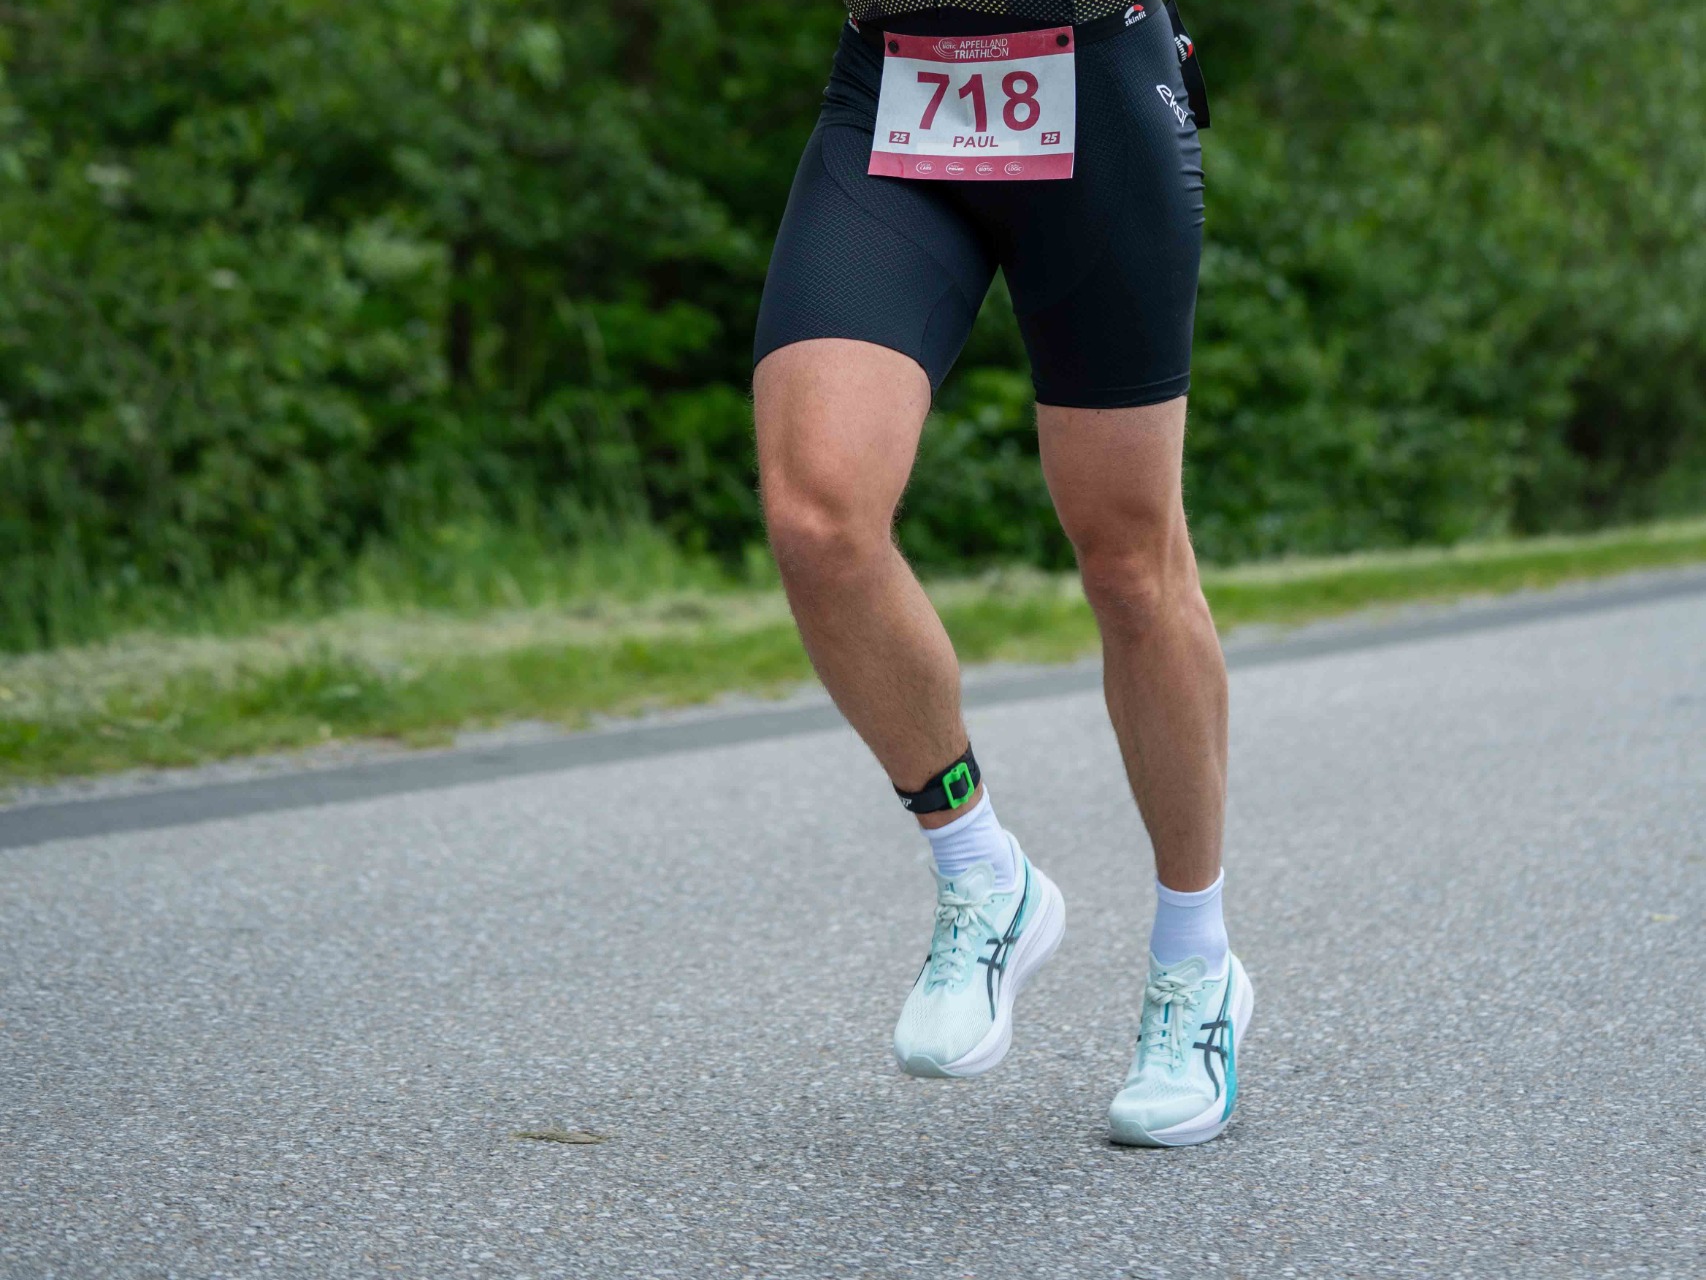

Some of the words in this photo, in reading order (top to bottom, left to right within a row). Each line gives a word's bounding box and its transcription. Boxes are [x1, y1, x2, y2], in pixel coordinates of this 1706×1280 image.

[1125, 11, 1146, 26] skinfit
[960, 38, 1008, 49] APFELLAND
[954, 47, 1009, 59] TRIATHLON
[917, 71, 1040, 132] 718
[891, 133, 907, 143] 25
[953, 136, 999, 148] PAUL
[1043, 133, 1058, 143] 25
